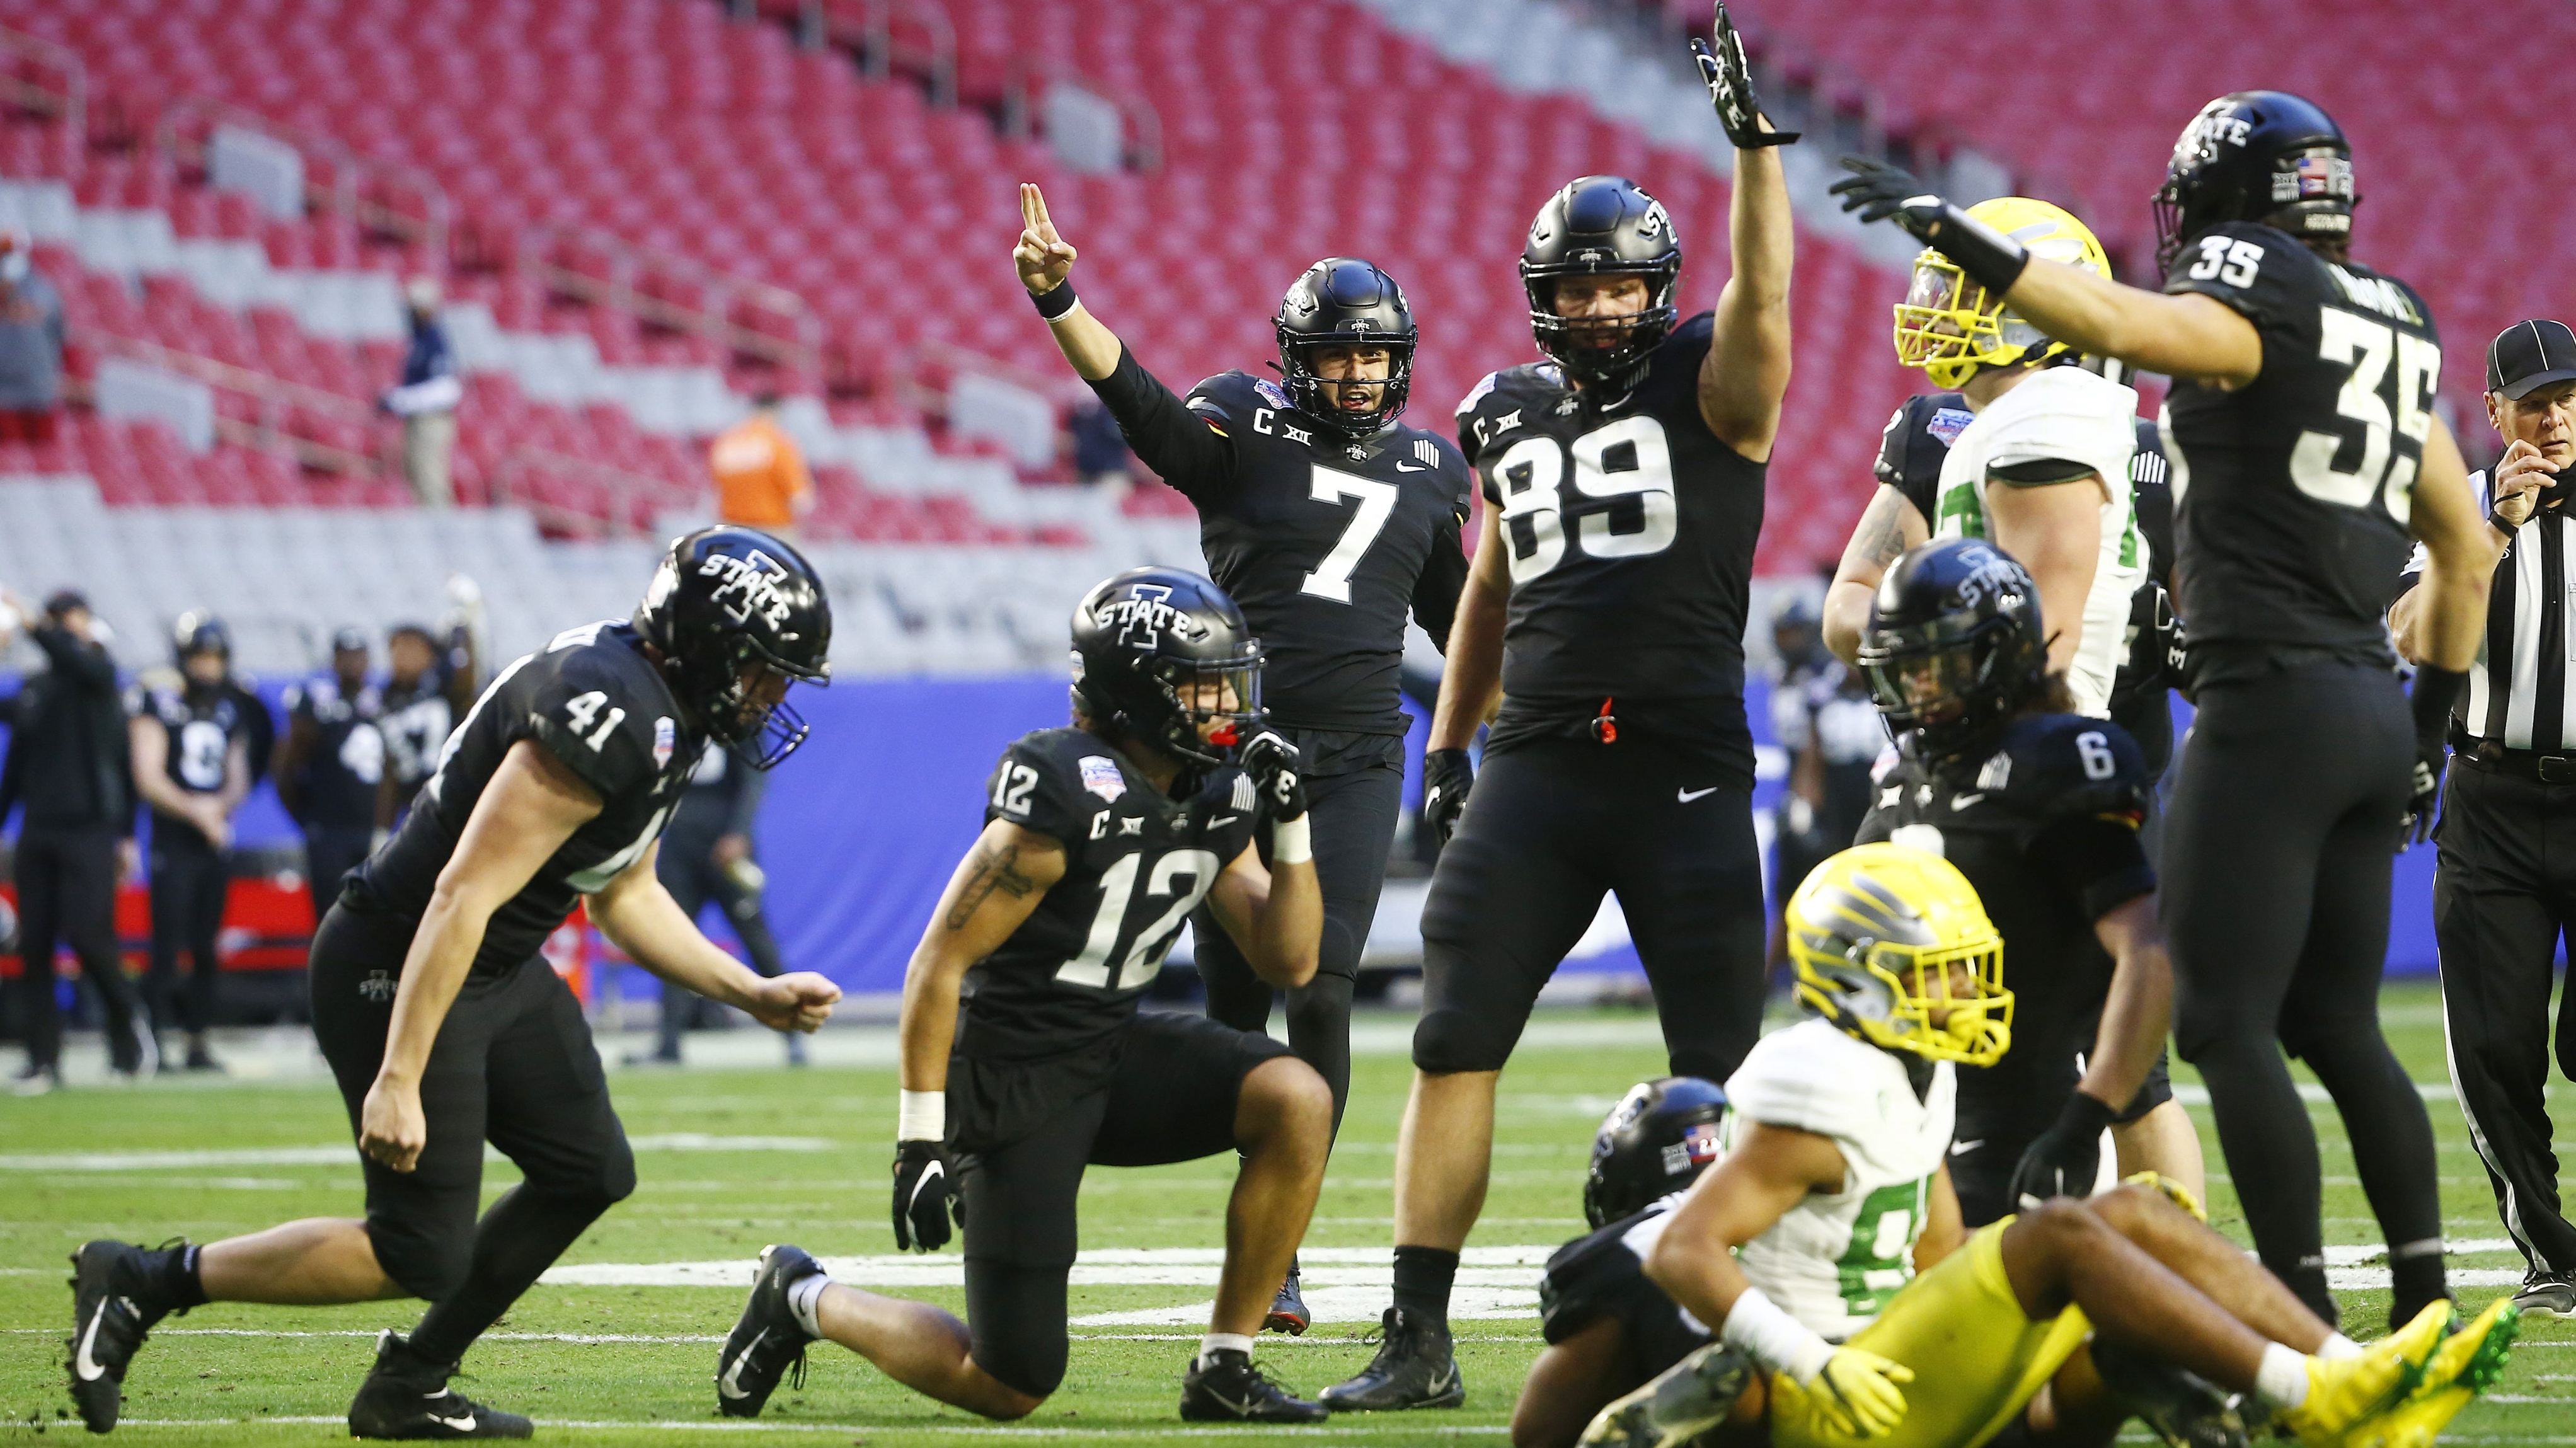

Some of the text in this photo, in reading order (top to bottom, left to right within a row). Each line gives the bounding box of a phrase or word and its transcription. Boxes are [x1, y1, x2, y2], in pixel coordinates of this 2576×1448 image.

[2188, 235, 2265, 289] 35
[1253, 408, 1314, 447] C XII
[1473, 416, 1490, 447] C
[1495, 408, 1522, 435] XII
[2289, 305, 2442, 525] 35
[1492, 415, 1678, 584] 89
[1297, 461, 1400, 606] 7
[698, 553, 791, 632] STATE
[1097, 600, 1192, 641] STATE
[566, 691, 626, 753] 41
[2076, 731, 2116, 781] 6
[992, 760, 1038, 816] 12
[1090, 809, 1111, 840] C
[1054, 848, 1221, 990] 12
